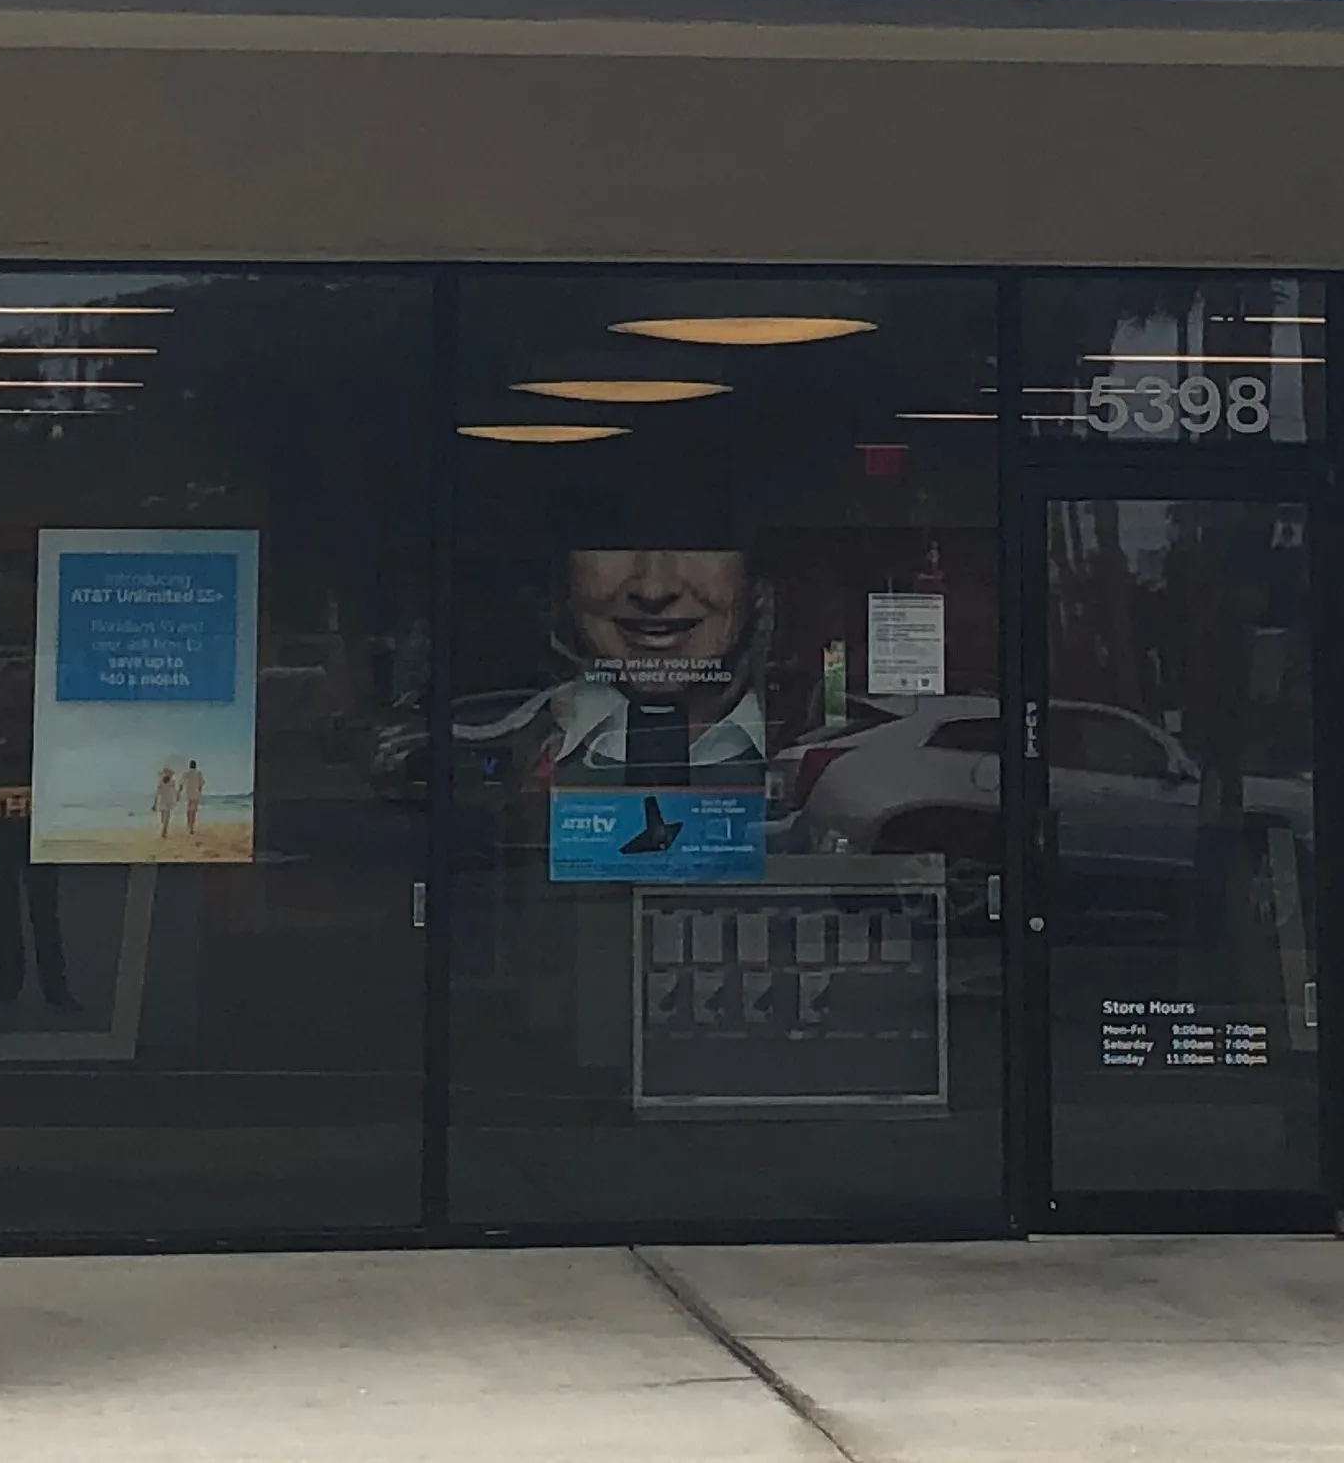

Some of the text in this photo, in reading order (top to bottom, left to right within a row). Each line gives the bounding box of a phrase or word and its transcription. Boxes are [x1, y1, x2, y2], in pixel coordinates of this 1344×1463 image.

[1086, 375, 1270, 434] 5398
[116, 588, 194, 603] Unlimited
[625, 658, 660, 670] WHAT
[664, 658, 689, 670] YOU
[691, 658, 722, 670] LOVE
[584, 671, 732, 683] WITH A VOICE COMMAND
[1024, 701, 1040, 758] PULL
[1102, 1000, 1196, 1015] Store Hours
[1102, 1024, 1147, 1036] Mon-Fri
[1102, 1039, 1154, 1052] Saturday
[1102, 1053, 1145, 1066] Sunday
